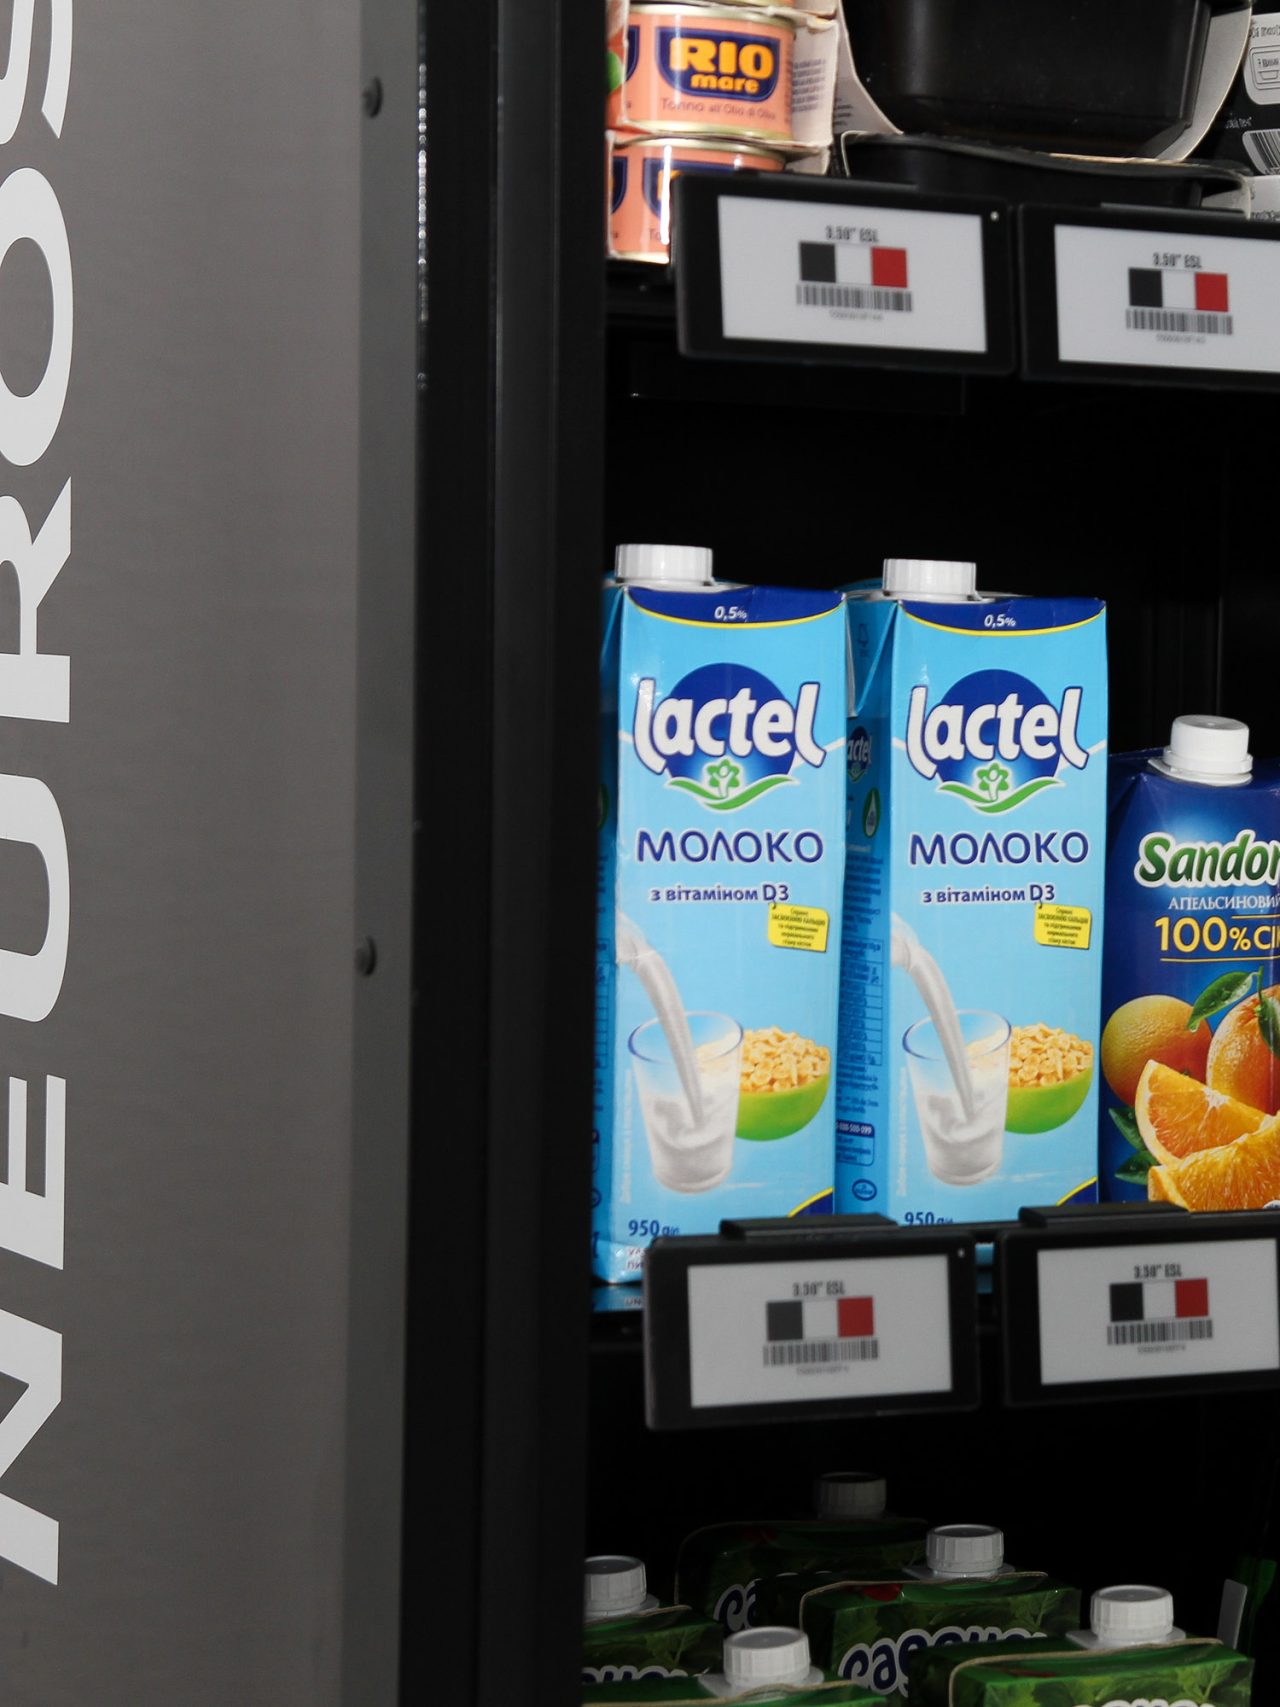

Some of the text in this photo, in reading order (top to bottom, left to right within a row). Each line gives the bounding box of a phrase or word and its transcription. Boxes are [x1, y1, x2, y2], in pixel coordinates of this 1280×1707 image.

[669, 37, 774, 80] RIO
[690, 73, 759, 94] mare
[1184, 254, 1202, 269] ESL
[714, 605, 748, 622] 0,5%
[983, 613, 1017, 629] 0,5%
[633, 678, 828, 775] lactel
[906, 686, 1089, 780] lactel
[847, 735, 872, 765] actel
[637, 830, 823, 863] МОЛОКО
[910, 832, 1089, 866] МОЛОКО
[665, 884, 759, 901] вітаміном
[763, 883, 790, 902] D3
[936, 884, 1026, 903] вітаміном
[1030, 883, 1055, 902] D3
[628, 1220, 661, 1236] 950
[826, 1280, 845, 1296] ESL
